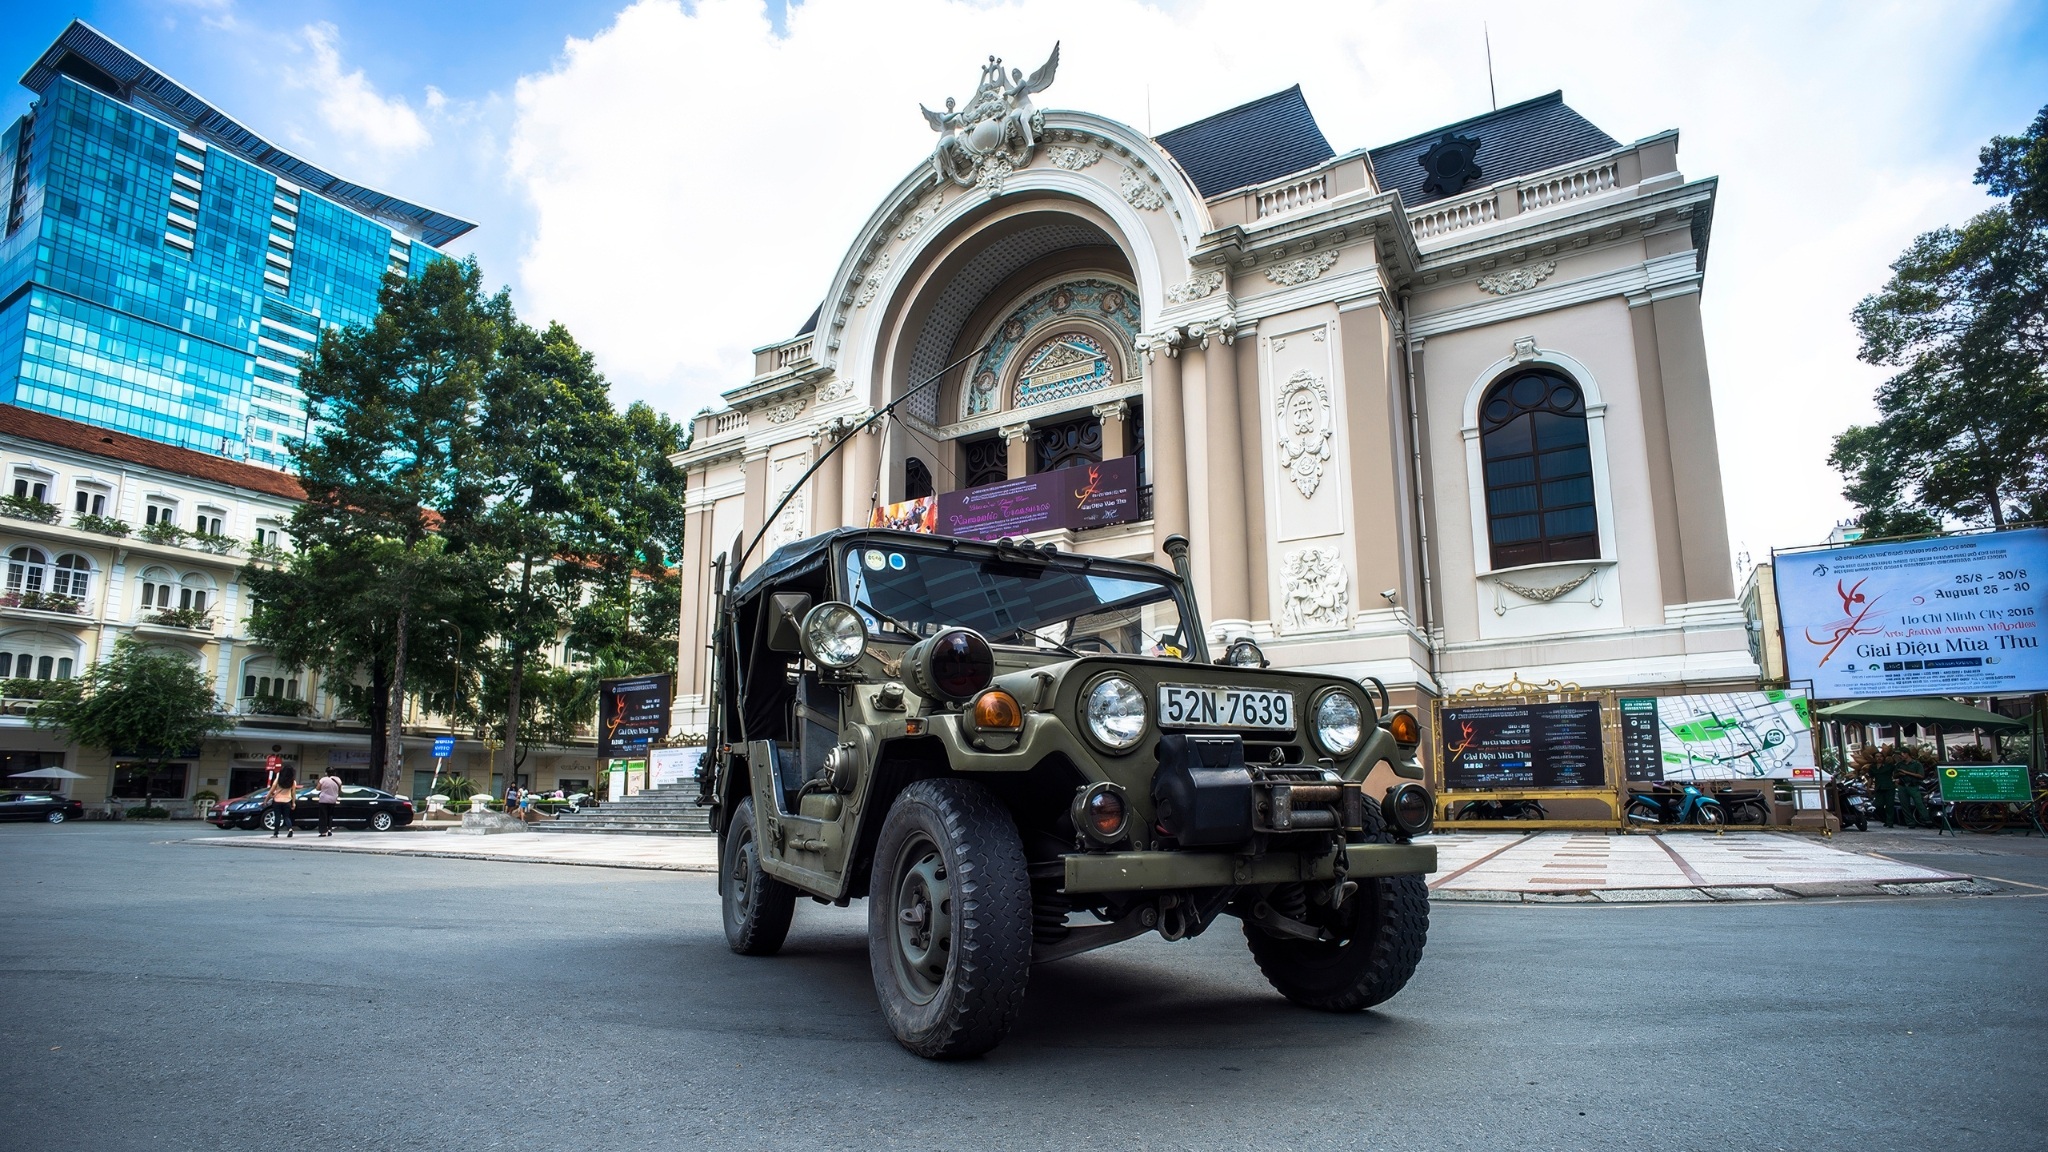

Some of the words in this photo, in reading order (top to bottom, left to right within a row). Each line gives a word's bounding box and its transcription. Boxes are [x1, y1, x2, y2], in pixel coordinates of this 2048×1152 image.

[1955, 573, 1983, 584] 25/8
[1998, 569, 2028, 580] 30/8
[1934, 587, 1979, 599] August
[1983, 585, 1998, 594] 25
[2014, 582, 2030, 591] 30
[1902, 616, 1919, 625] Ho
[1922, 613, 1942, 623] Chi
[1945, 611, 1976, 622] Minh
[1980, 609, 2003, 619] City
[2007, 607, 2035, 617] 2015
[1856, 644, 1891, 658] Giai
[1896, 640, 1940, 657] Điệu
[1946, 637, 1990, 652] Mùa
[1994, 635, 2039, 650] Thu
